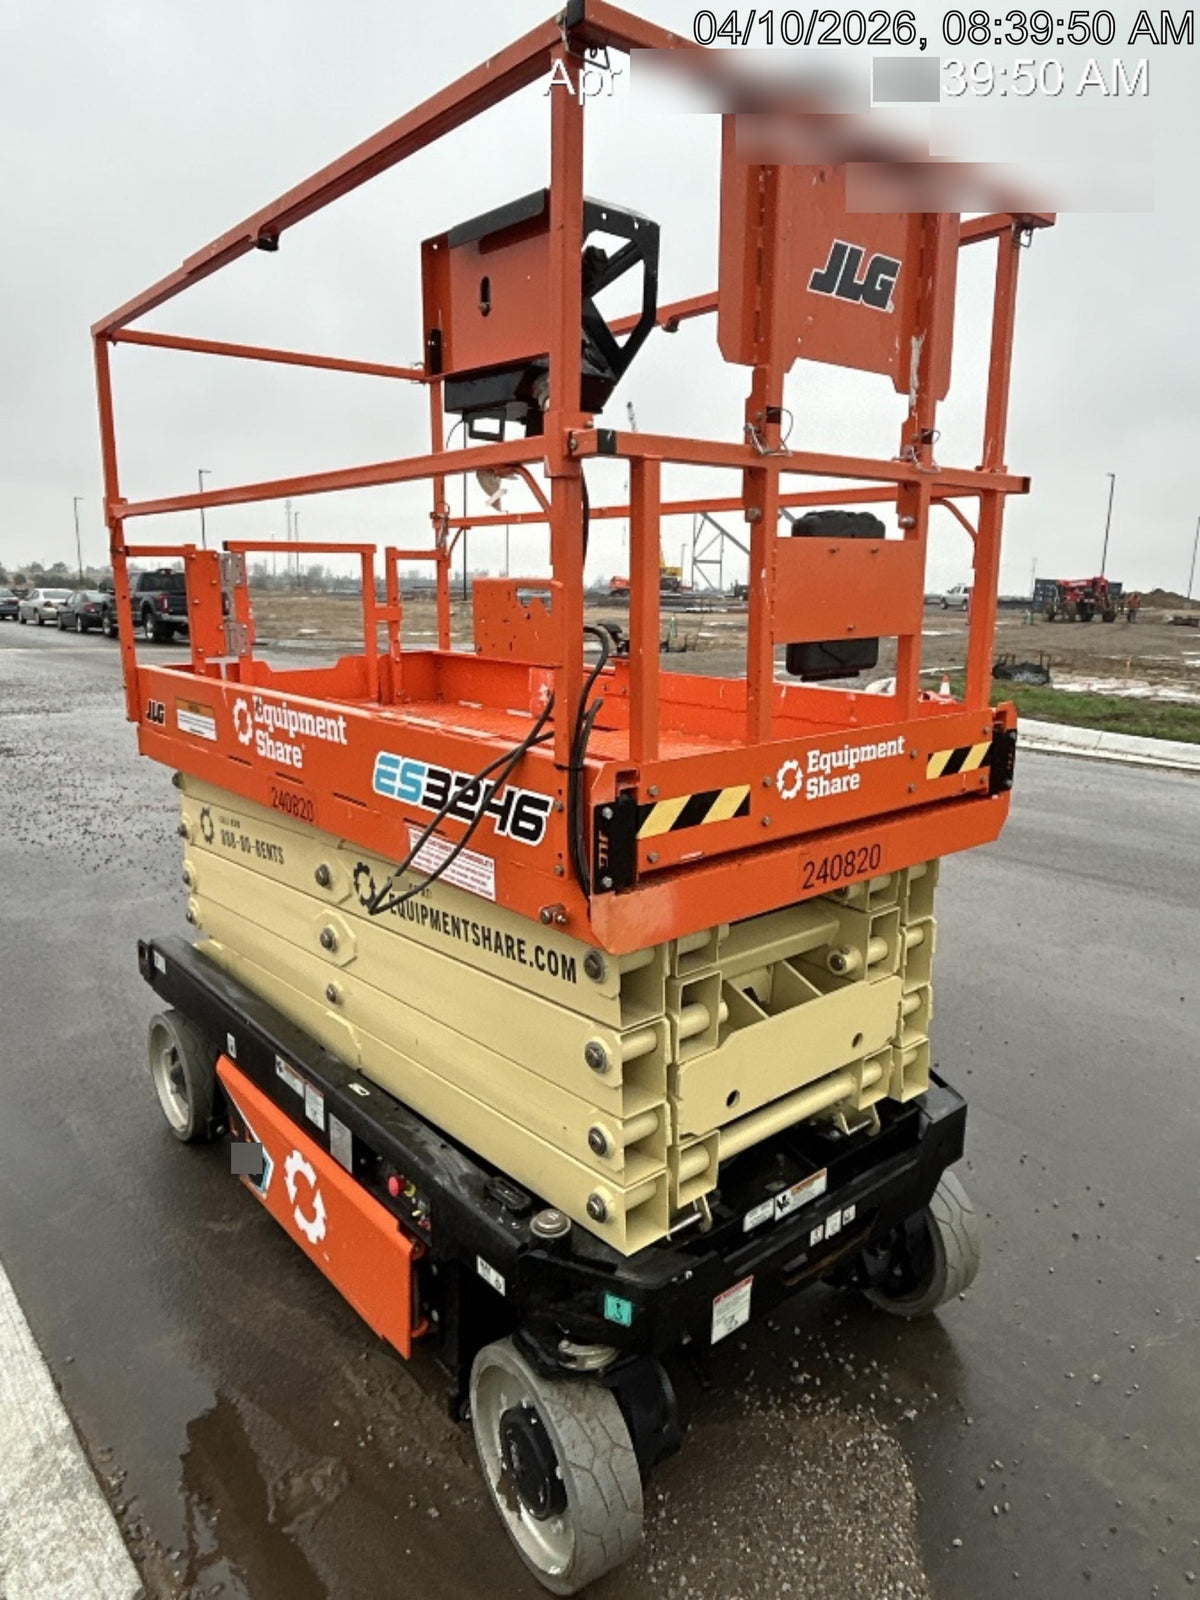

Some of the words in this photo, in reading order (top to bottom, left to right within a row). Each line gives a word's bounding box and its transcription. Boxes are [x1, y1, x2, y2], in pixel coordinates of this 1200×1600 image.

[808, 239, 901, 312] JLG
[146, 699, 166, 727] JLG
[253, 696, 347, 744] Equipment
[257, 730, 303, 768] Share
[806, 735, 905, 774] Equipment
[271, 786, 315, 823] 240820
[373, 751, 554, 846] ES3246
[805, 771, 861, 801] Share
[802, 843, 883, 891] 240820
